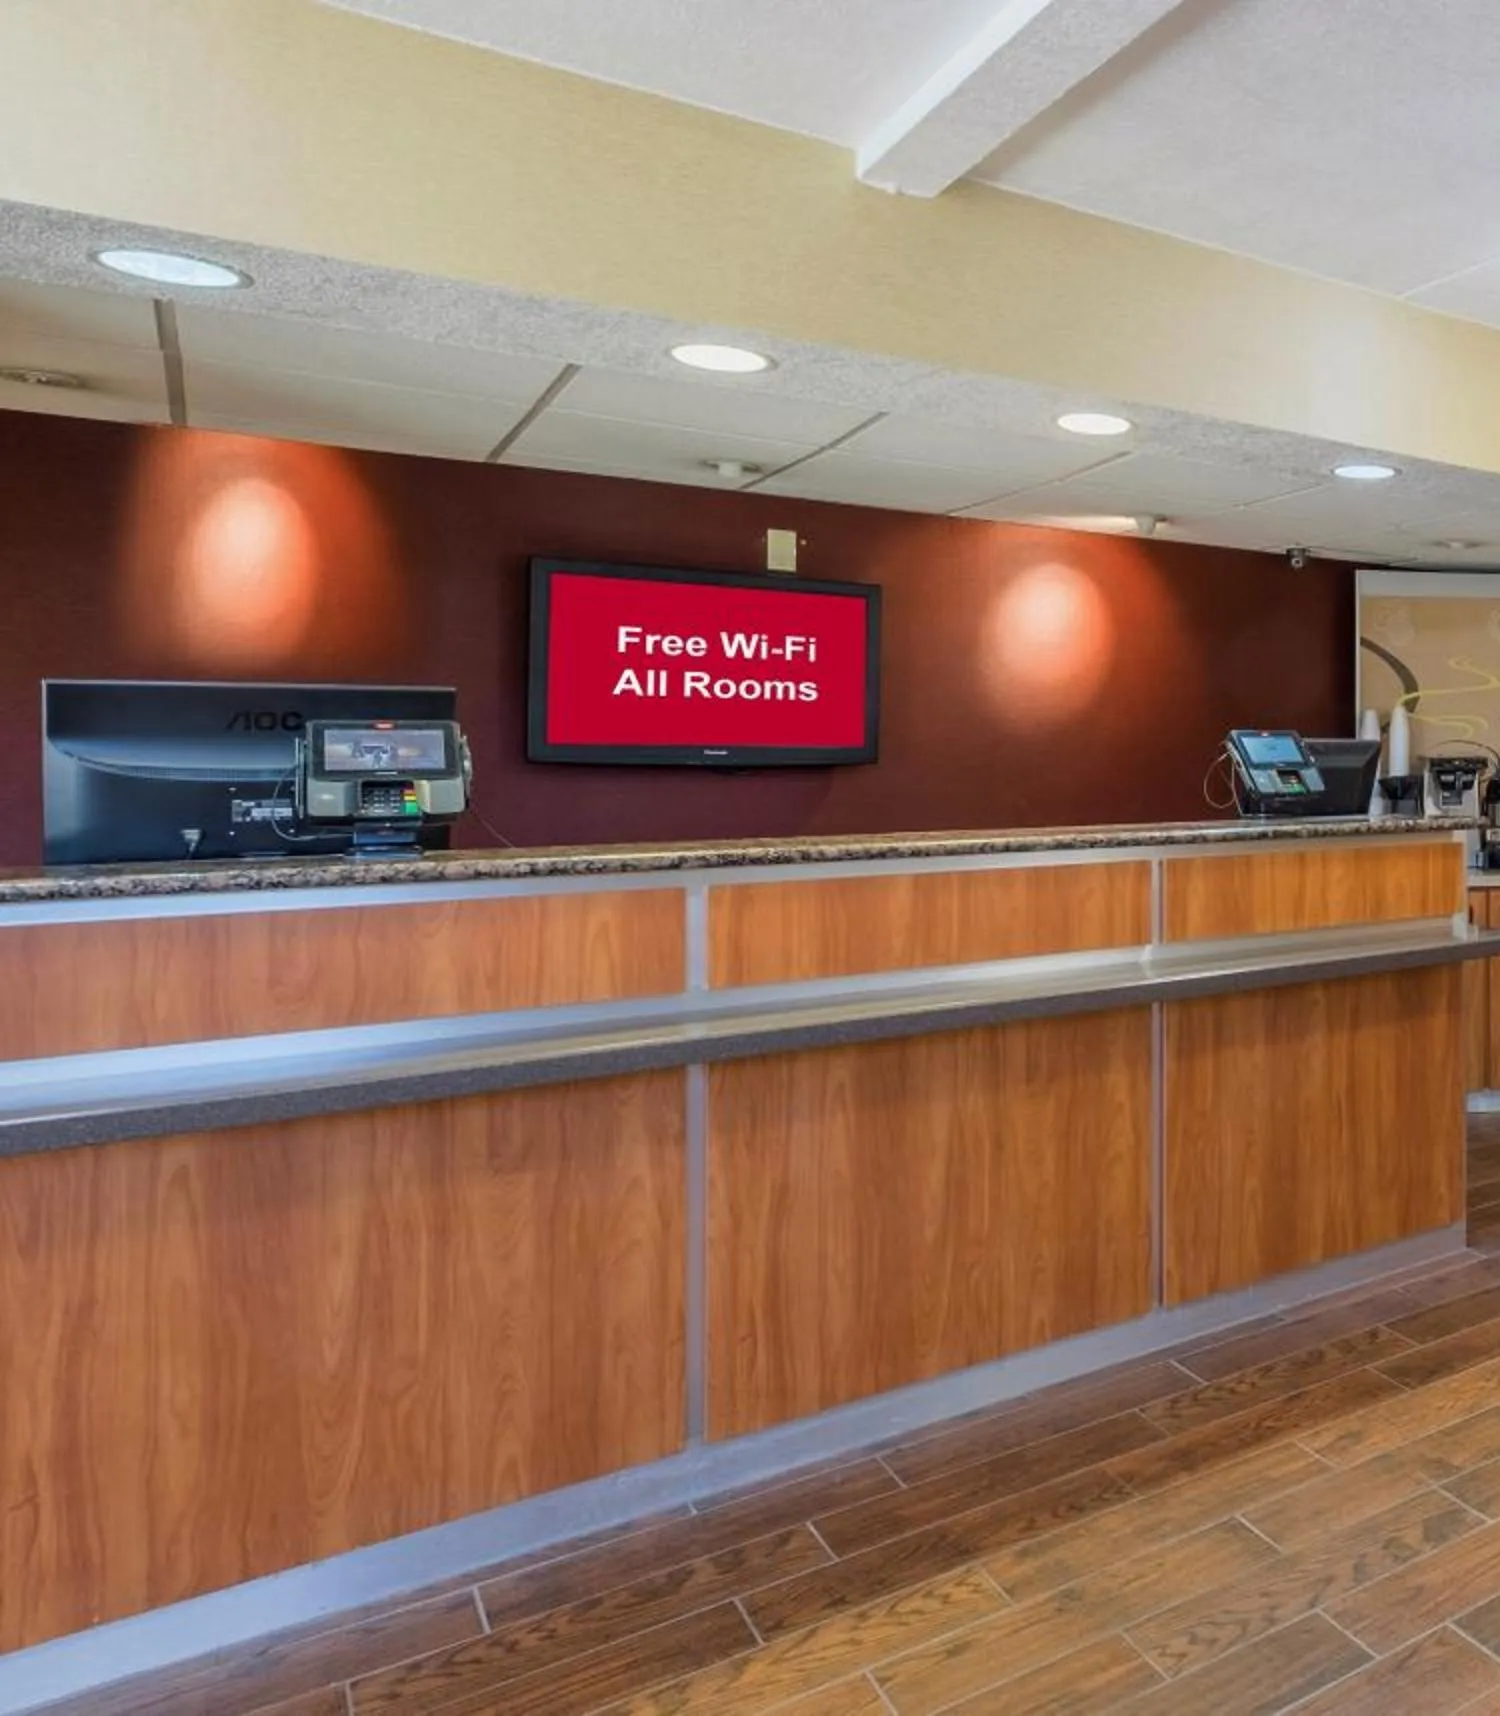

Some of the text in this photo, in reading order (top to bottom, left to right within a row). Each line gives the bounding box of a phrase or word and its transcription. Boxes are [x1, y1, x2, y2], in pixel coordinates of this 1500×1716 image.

[617, 625, 817, 662] Free Wi-Fi
[612, 668, 819, 701] All Rooms
